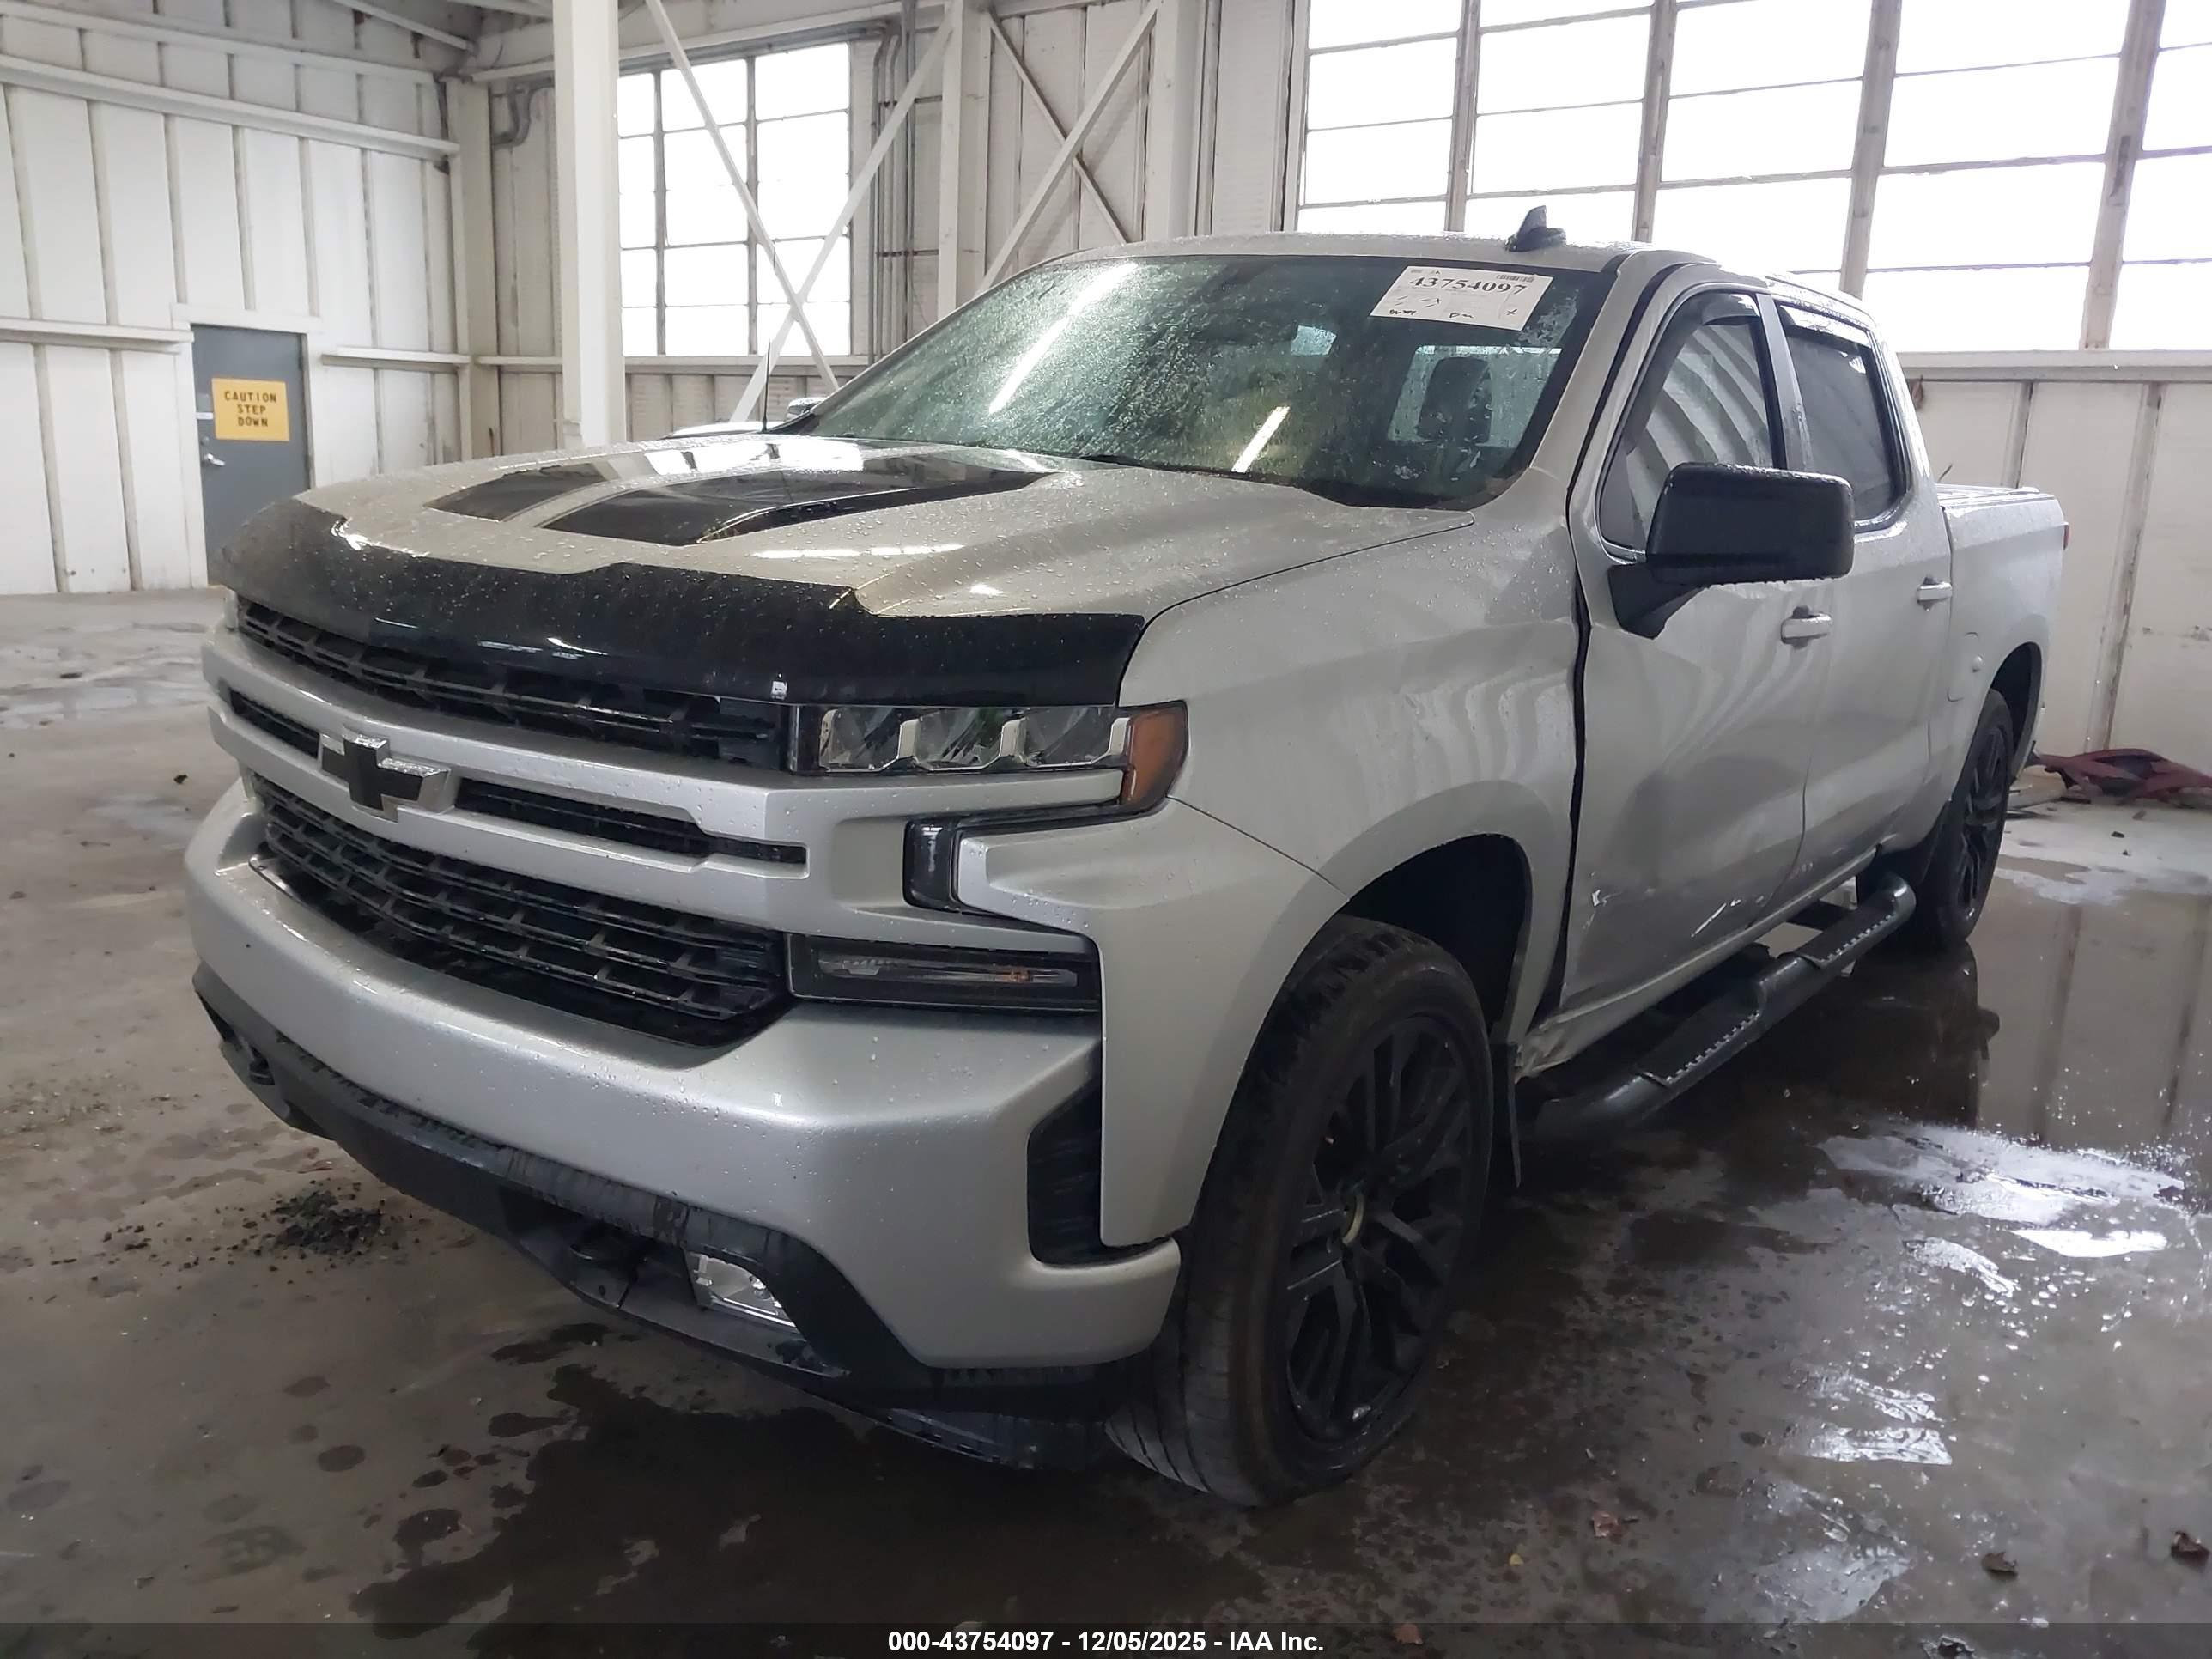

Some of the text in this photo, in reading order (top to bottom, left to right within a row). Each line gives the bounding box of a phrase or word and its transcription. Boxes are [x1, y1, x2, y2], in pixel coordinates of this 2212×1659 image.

[1410, 276, 1527, 295] 43754097
[224, 391, 276, 403] CAUTION
[237, 404, 266, 415] STEP
[238, 416, 268, 427] DOWN
